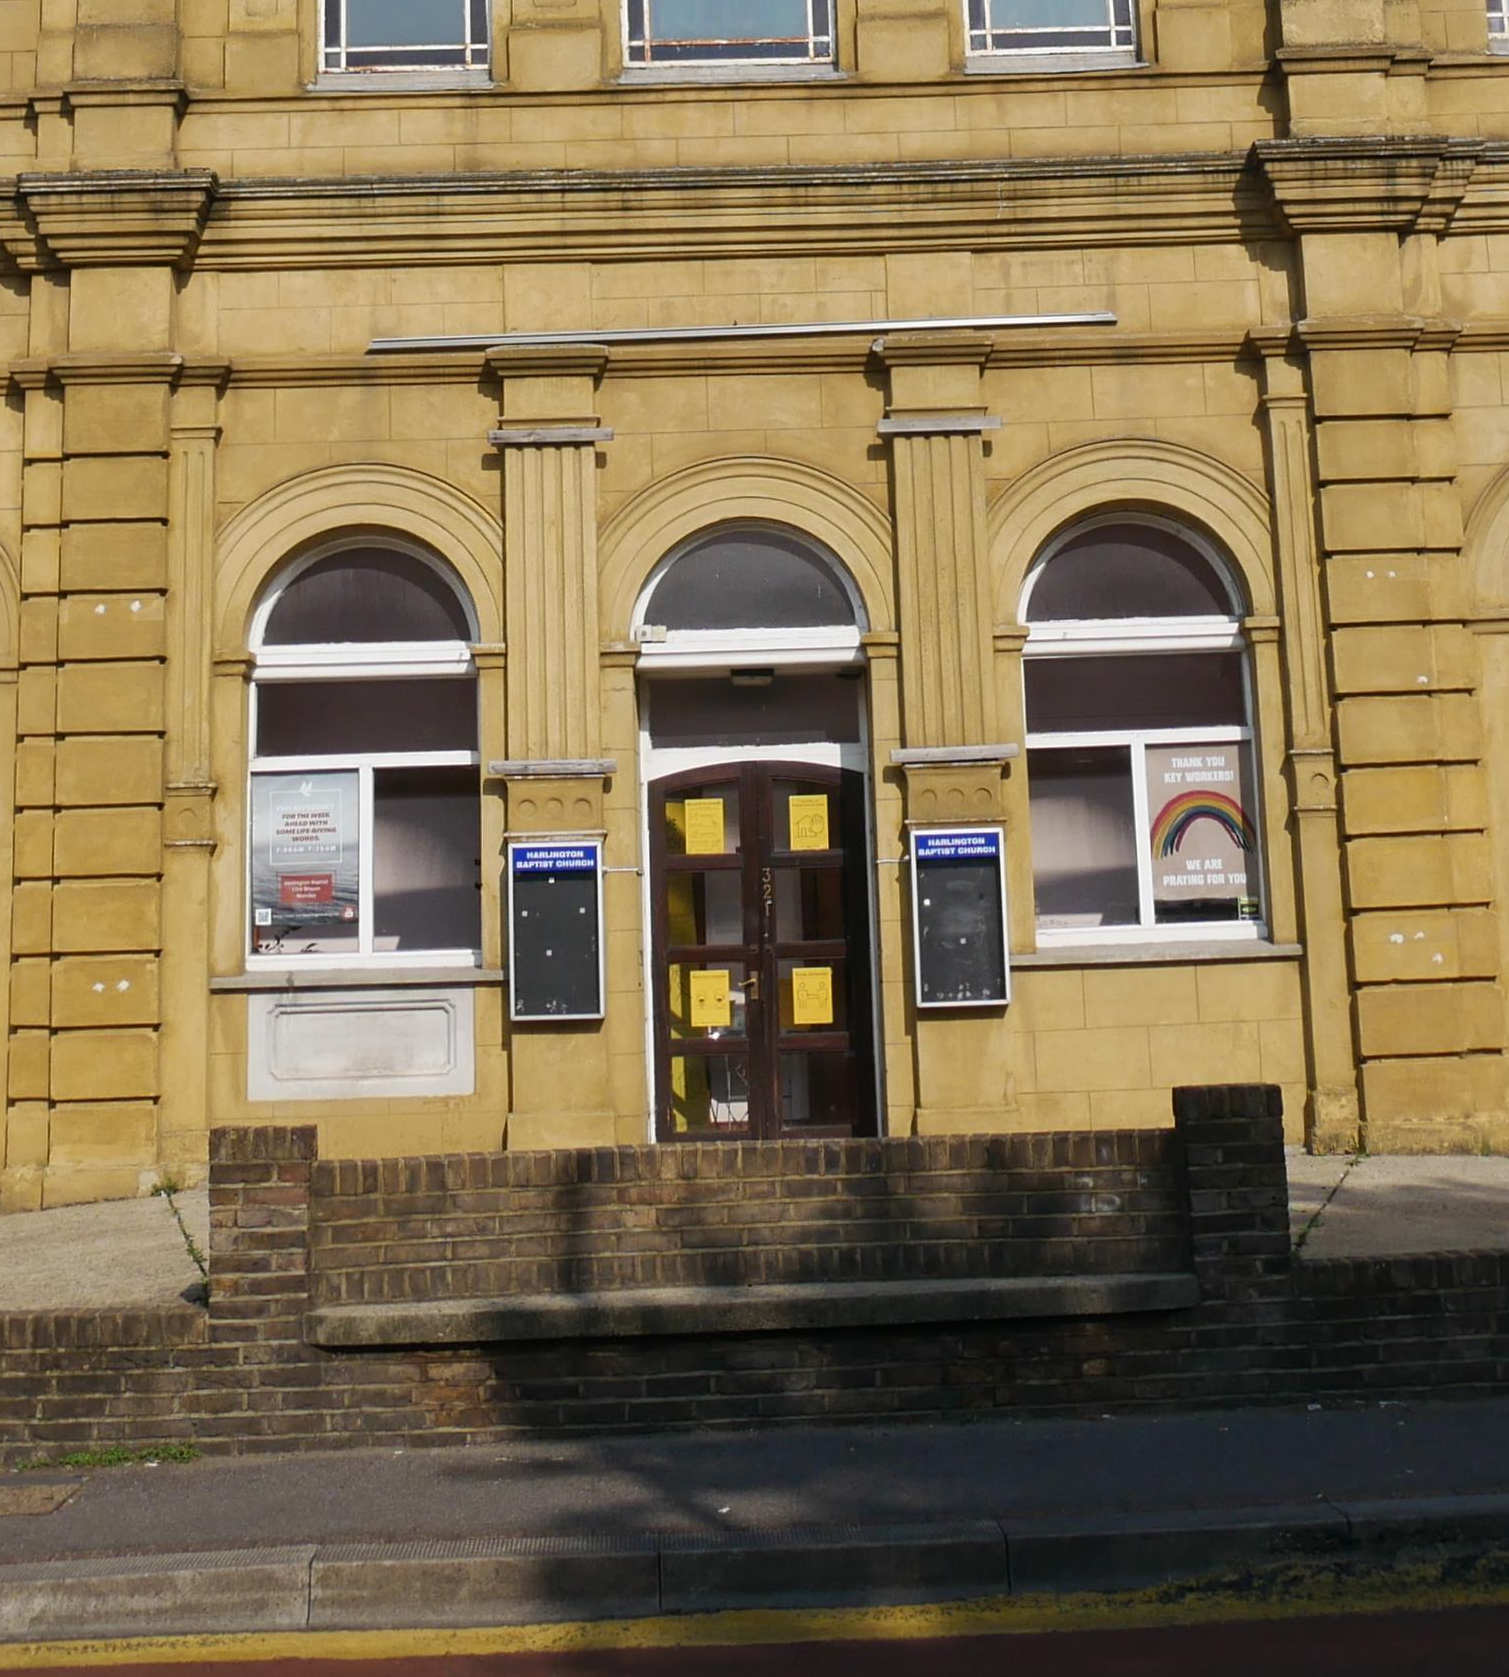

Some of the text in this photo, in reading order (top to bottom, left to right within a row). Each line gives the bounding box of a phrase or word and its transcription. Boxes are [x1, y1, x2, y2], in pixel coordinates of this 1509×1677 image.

[1171, 756, 1225, 768] THANK YOU
[1164, 770, 1233, 783] KEY WORKERS!
[928, 837, 985, 846] HARLINGTON
[526, 851, 584, 859] HARLINGTON
[918, 846, 995, 856] BAPTIST CHURCH
[556, 859, 594, 867] CHURCH
[1186, 859, 1222, 870] WE ARE
[1163, 873, 1246, 886] PRAYING FOR YOU
